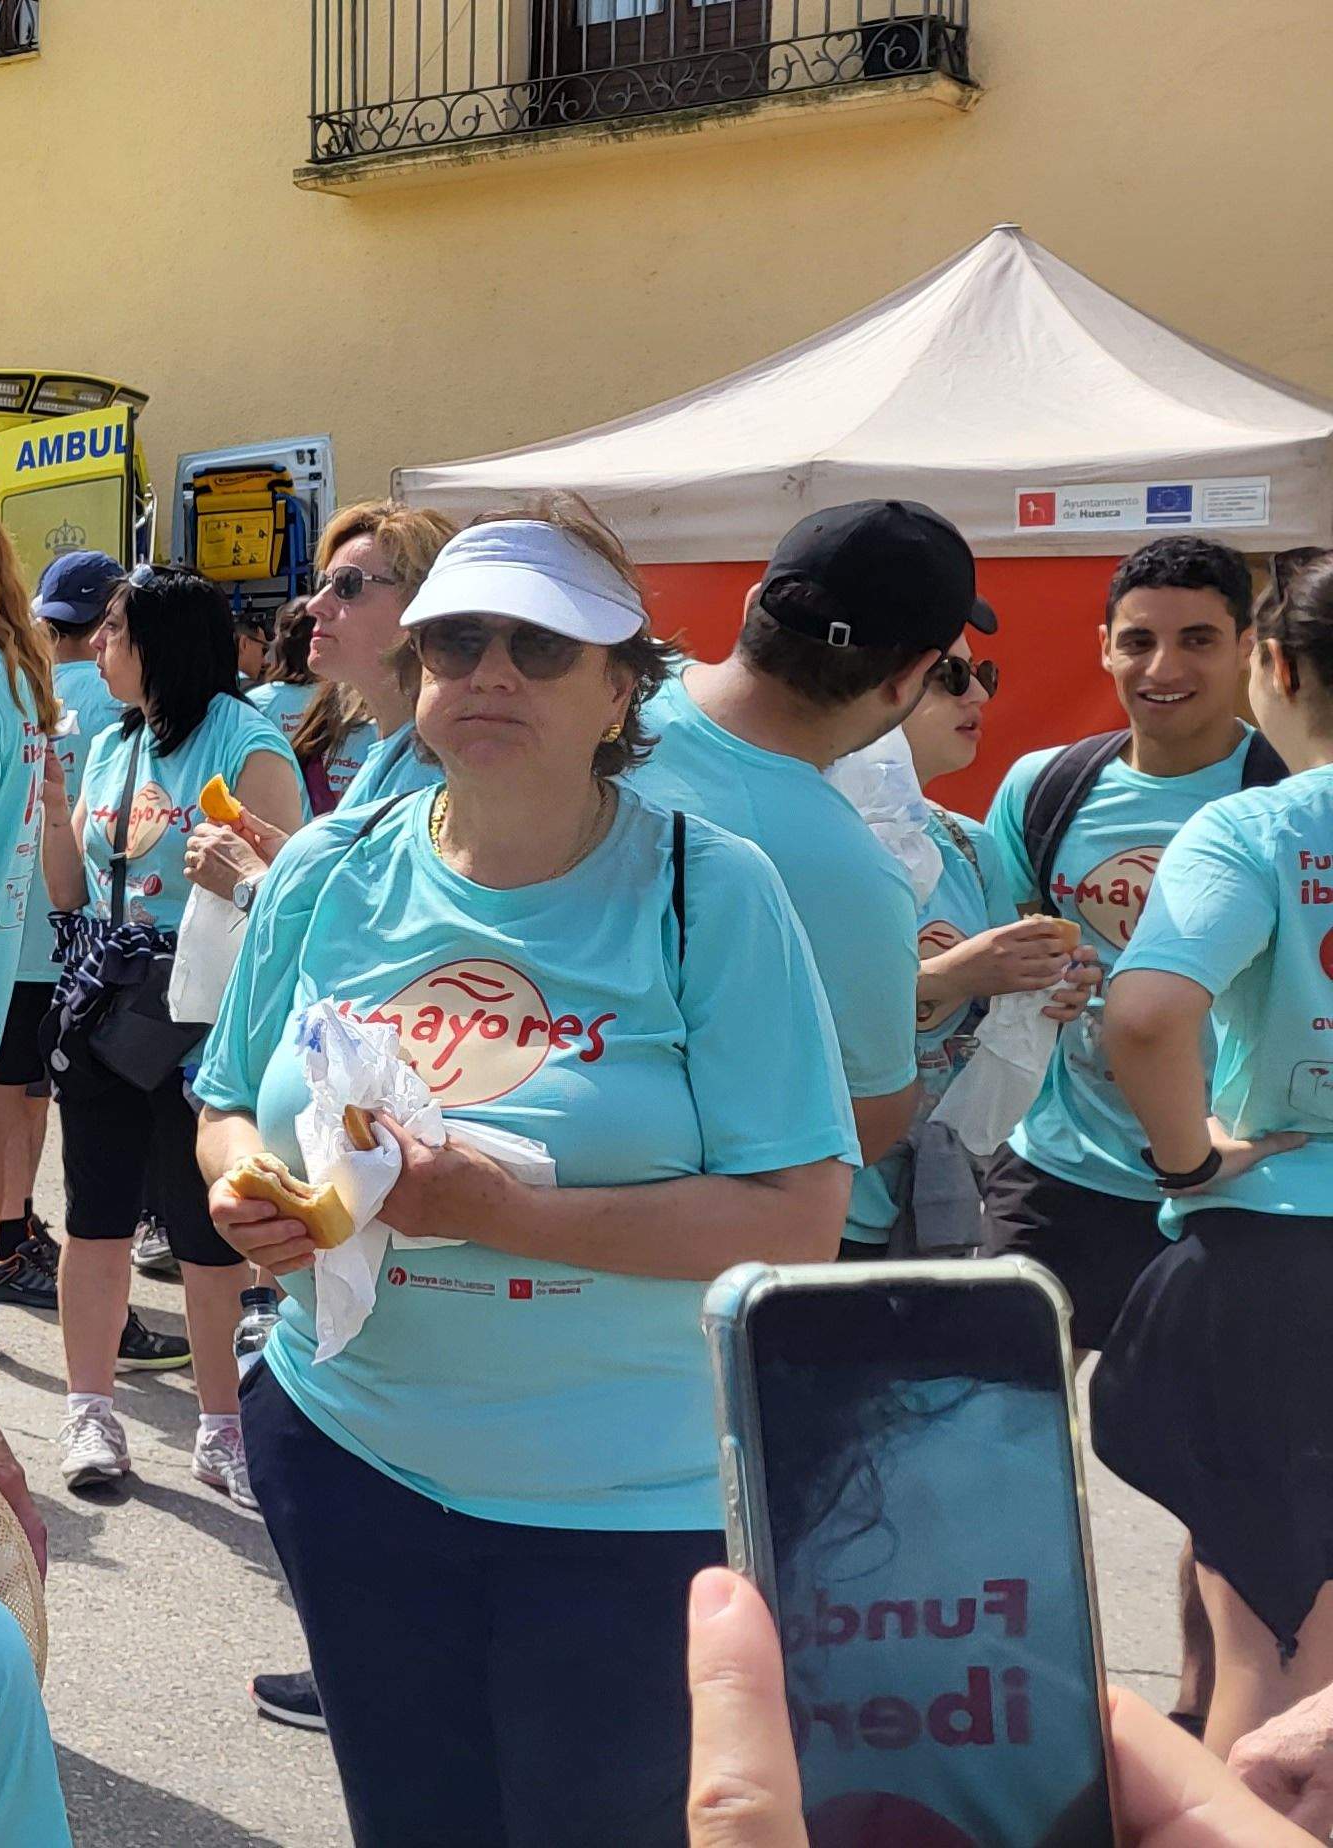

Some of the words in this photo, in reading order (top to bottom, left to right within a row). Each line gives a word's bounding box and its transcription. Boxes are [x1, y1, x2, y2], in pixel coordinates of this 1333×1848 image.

[1062, 497, 1140, 509] Ayuntamiento
[1062, 511, 1076, 519] de
[1079, 509, 1121, 518] Huesca
